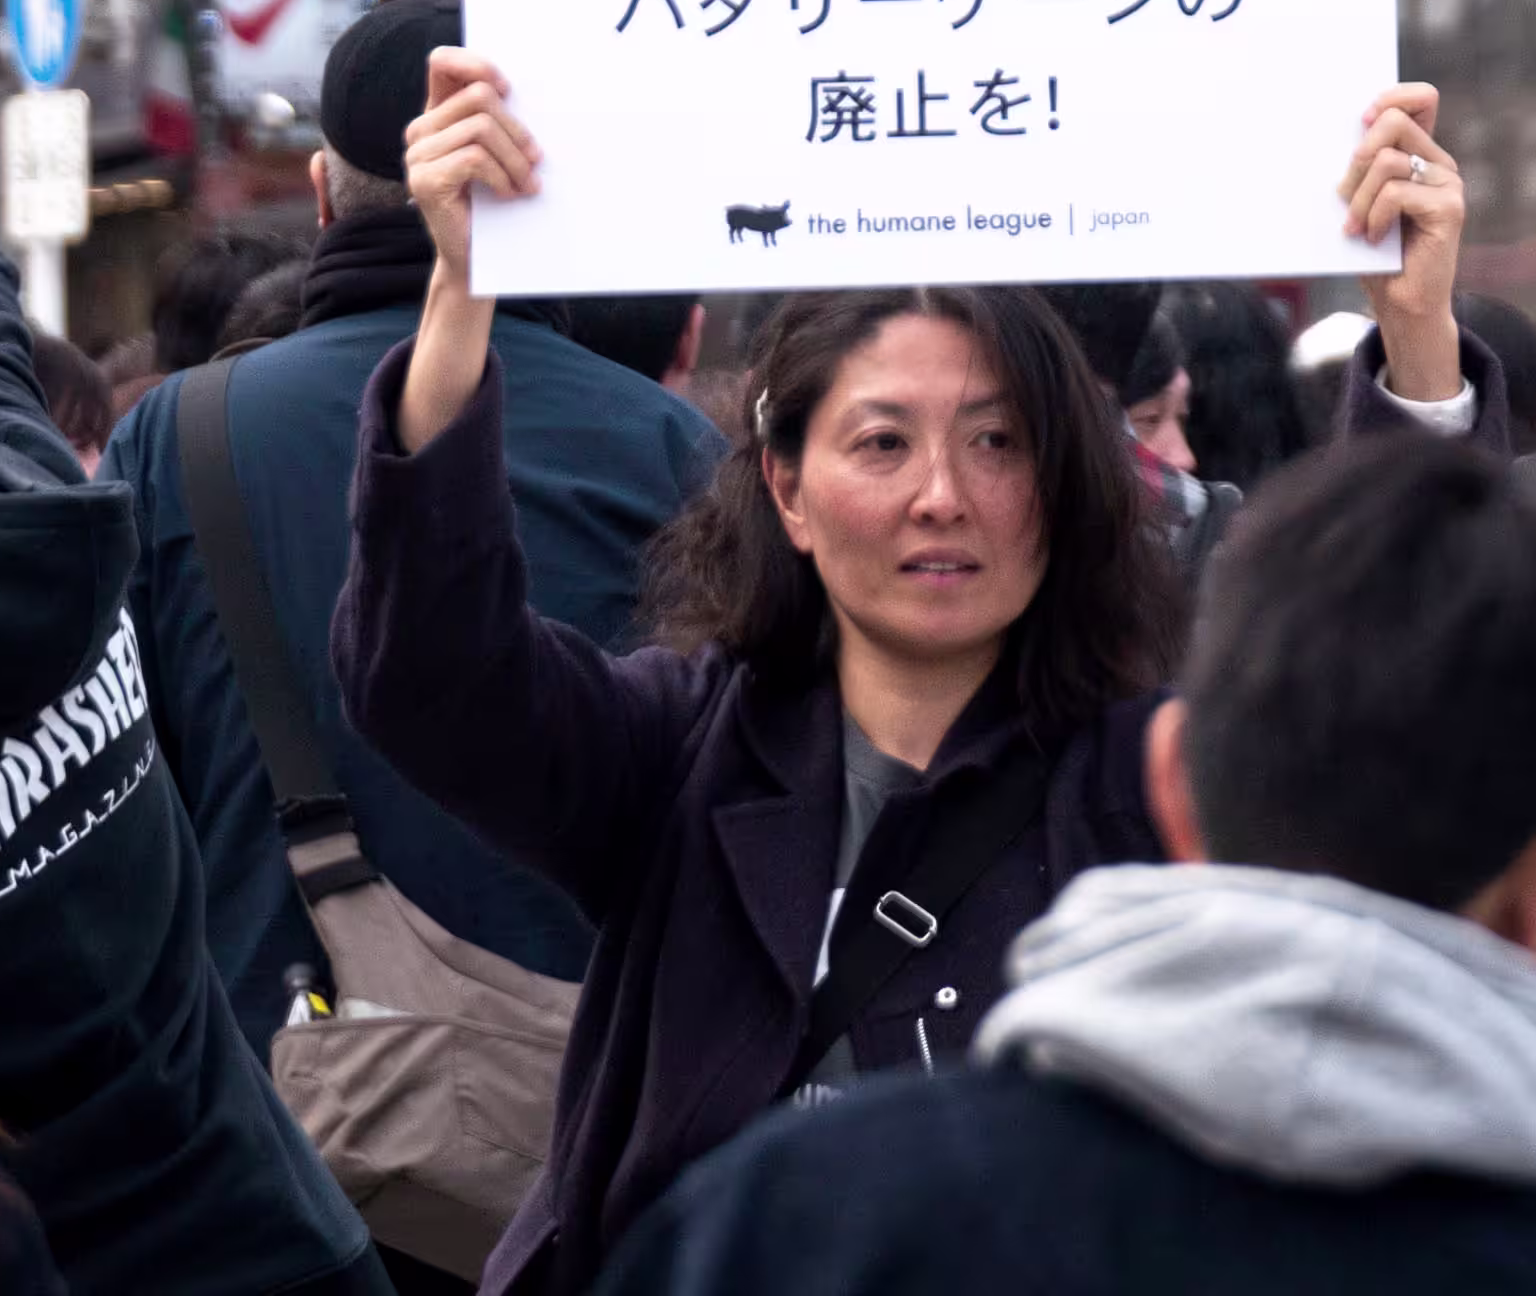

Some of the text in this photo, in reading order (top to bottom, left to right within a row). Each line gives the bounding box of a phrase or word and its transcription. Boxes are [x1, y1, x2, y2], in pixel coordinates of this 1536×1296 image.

[805, 68, 1061, 143] 廃止を!
[808, 204, 1150, 236] the humane league japan
